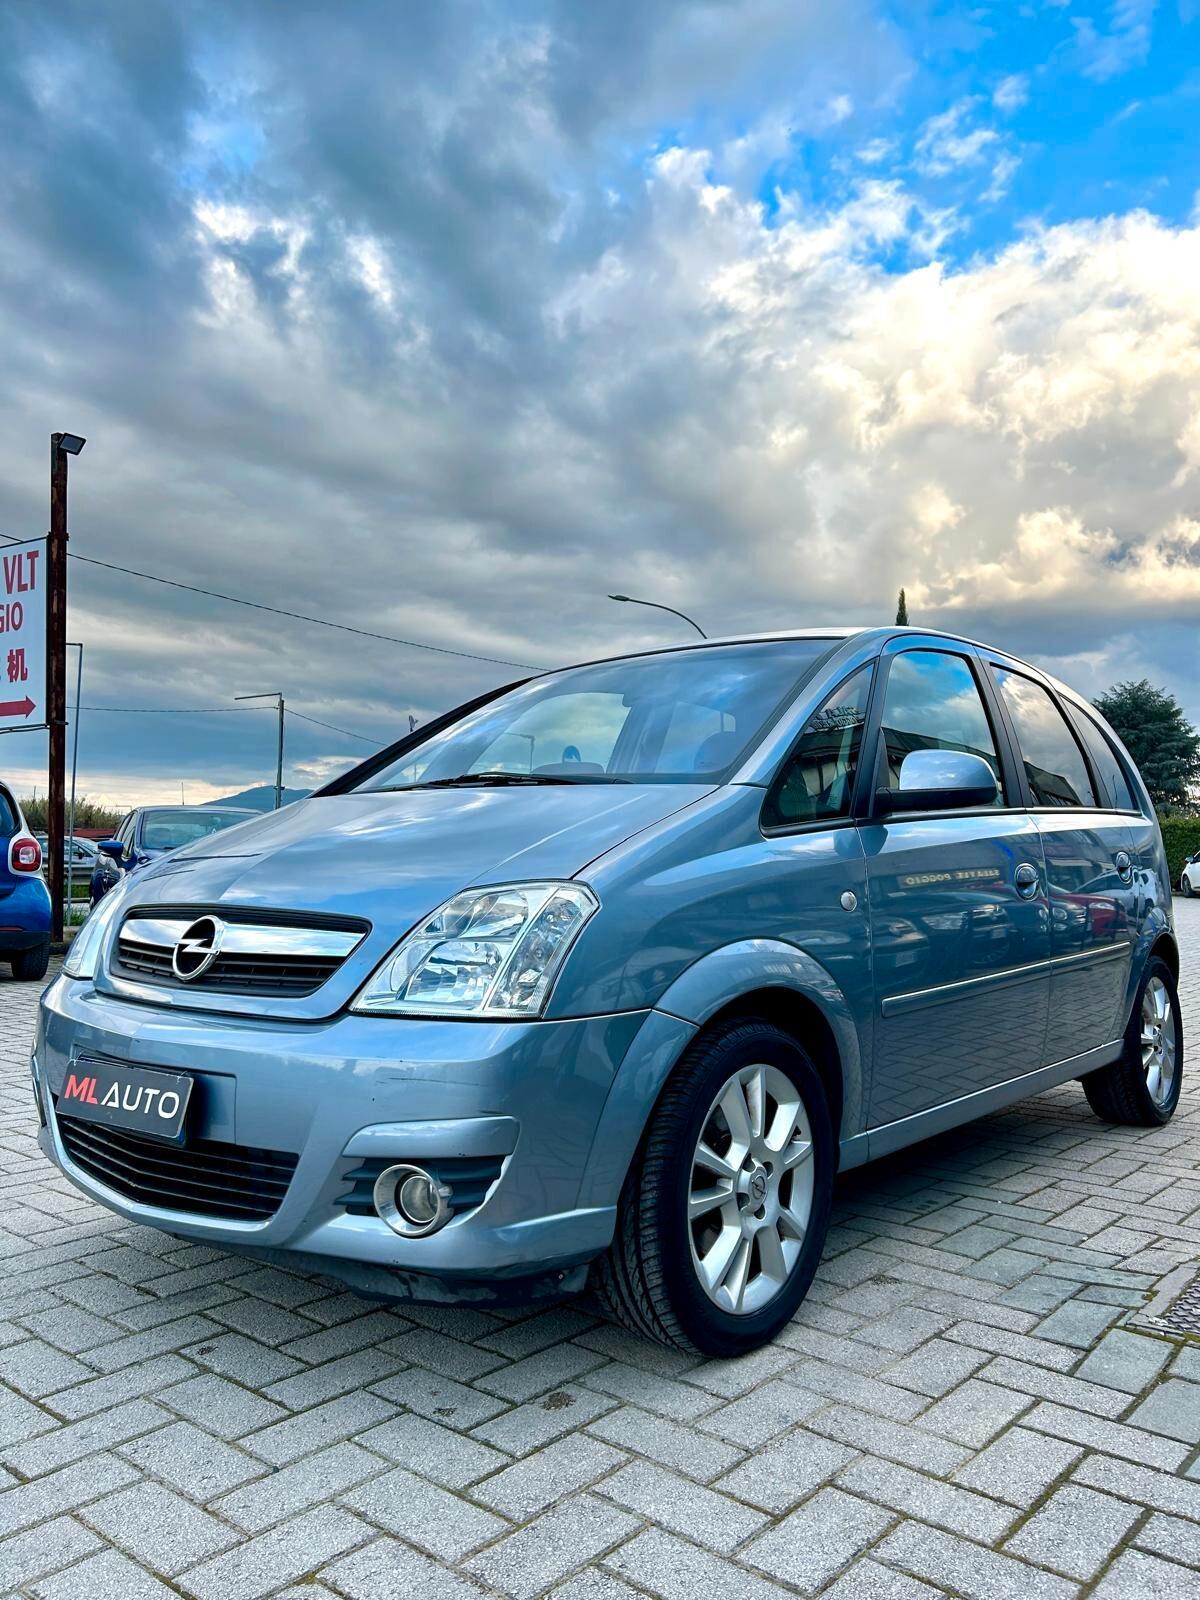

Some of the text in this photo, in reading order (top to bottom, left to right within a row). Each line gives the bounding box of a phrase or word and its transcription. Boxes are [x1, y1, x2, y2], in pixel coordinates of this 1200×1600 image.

[3, 550, 39, 594] VLT
[7, 648, 28, 682] 机
[100, 1081, 180, 1119] AUTO
